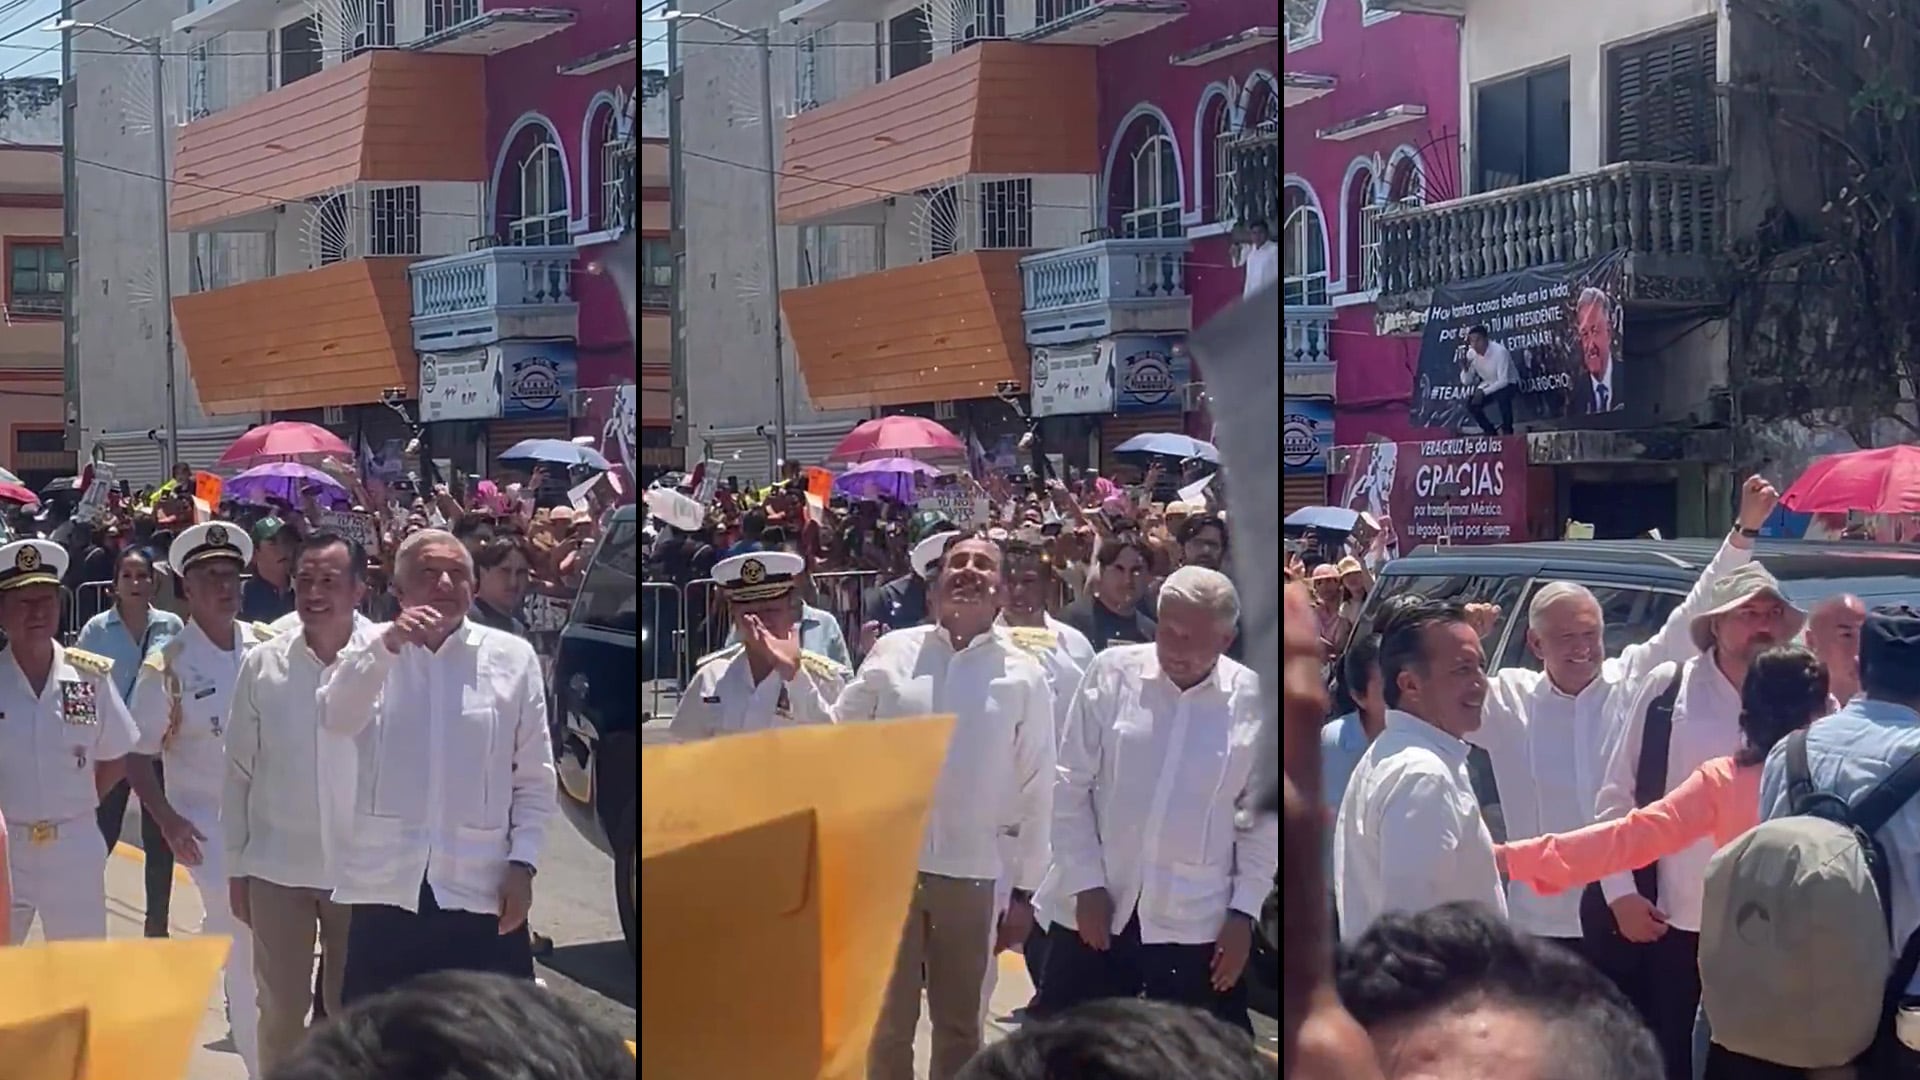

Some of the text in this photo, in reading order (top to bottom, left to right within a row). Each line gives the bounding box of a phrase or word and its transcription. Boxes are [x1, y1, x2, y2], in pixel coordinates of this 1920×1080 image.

[1452, 304, 1475, 318] tantas
[1476, 300, 1500, 314] cosas
[1501, 292, 1527, 308] bellas
[1528, 291, 1539, 303] en
[1539, 287, 1548, 301] la
[1439, 328, 1458, 342] por
[1491, 313, 1502, 333] TÚ
[1502, 317, 1514, 331] MI
[1422, 438, 1502, 456] VERACRUZ le da las
[1416, 462, 1503, 496] GRACIAS
[1414, 505, 1426, 519] por
[1416, 522, 1442, 538] legado
[1443, 522, 1464, 536] vvirá
[1465, 526, 1481, 540] por
[1482, 523, 1511, 539] siempre
